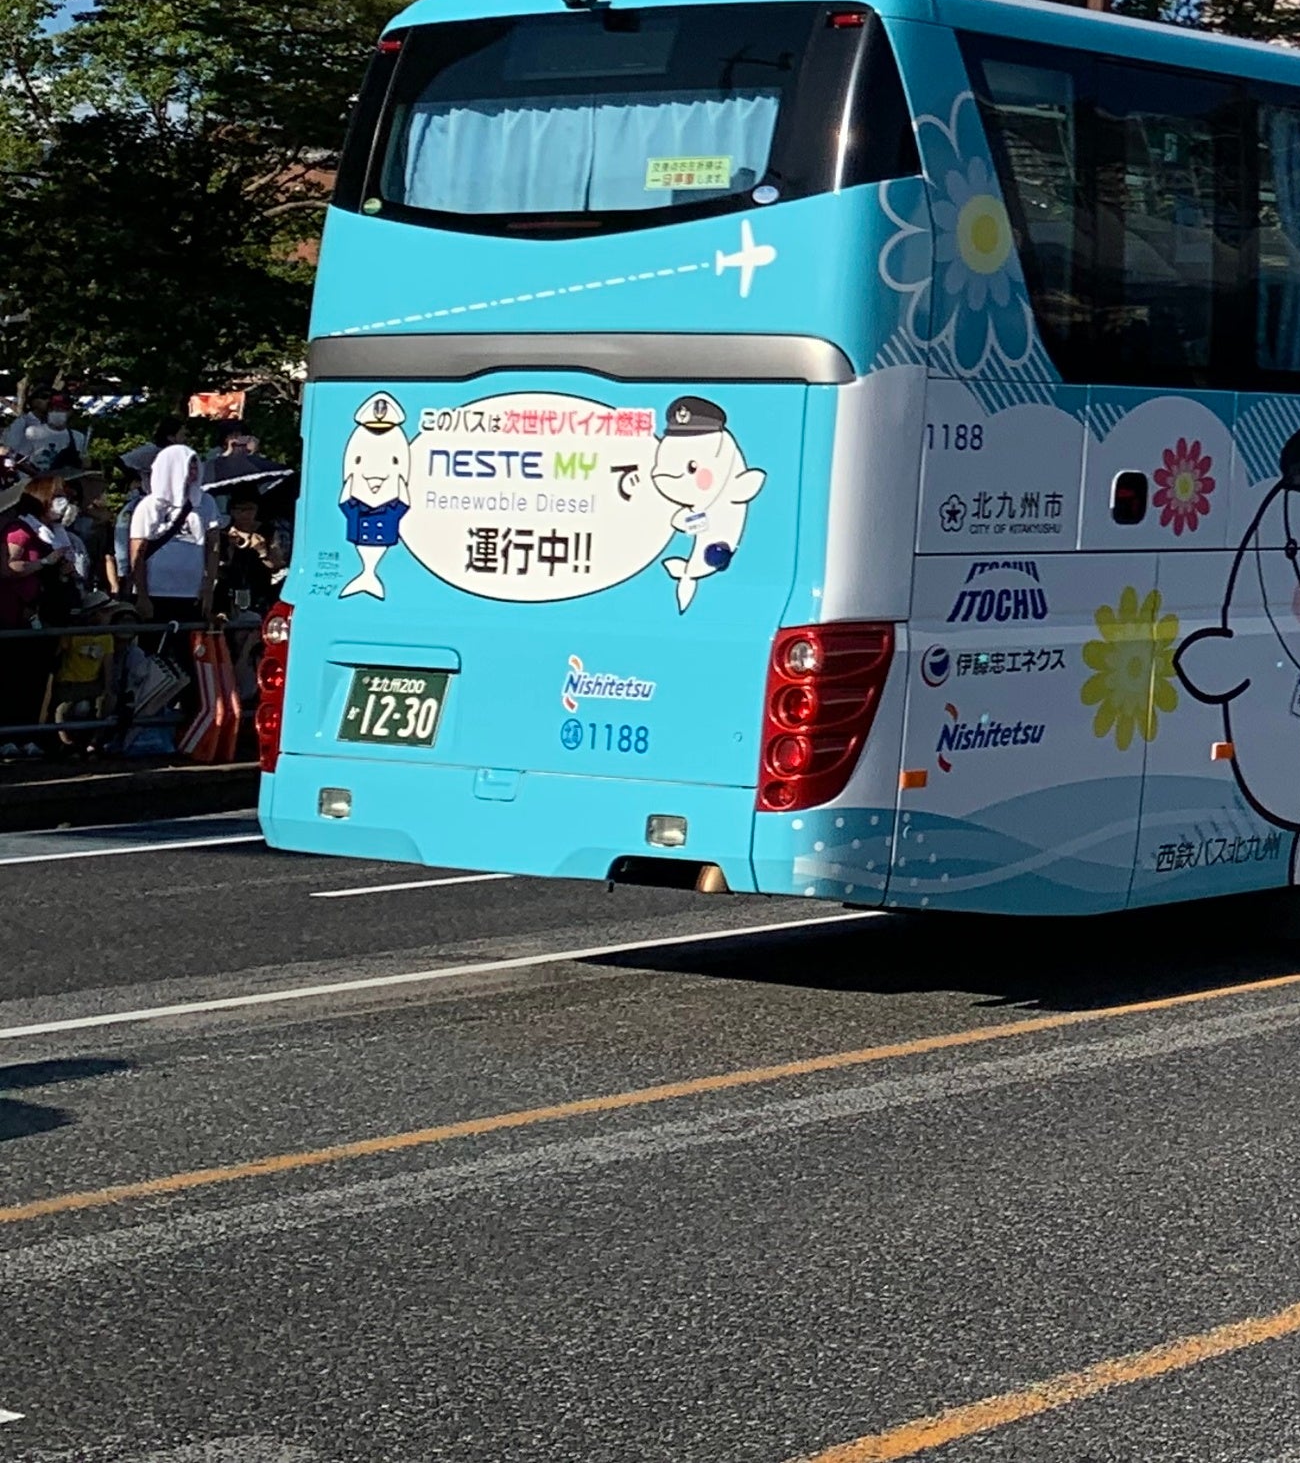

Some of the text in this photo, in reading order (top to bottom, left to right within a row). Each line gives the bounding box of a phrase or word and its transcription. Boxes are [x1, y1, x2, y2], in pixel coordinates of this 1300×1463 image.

[927, 424, 983, 450] 1188
[429, 449, 640, 502] NESTE MY で
[426, 491, 596, 514] Renewable Diesel
[971, 492, 1063, 519] 北九州市
[969, 524, 990, 534] CITY
[994, 524, 1006, 534] OF
[946, 588, 1048, 622] ITOCHU
[956, 649, 1066, 676] 伊藤忠エネクス
[564, 673, 653, 698] Nishitetsu
[588, 722, 649, 754] 1188
[936, 721, 1046, 752] Nishitetsu
[1156, 835, 1282, 873] 西鉄バス北九州
